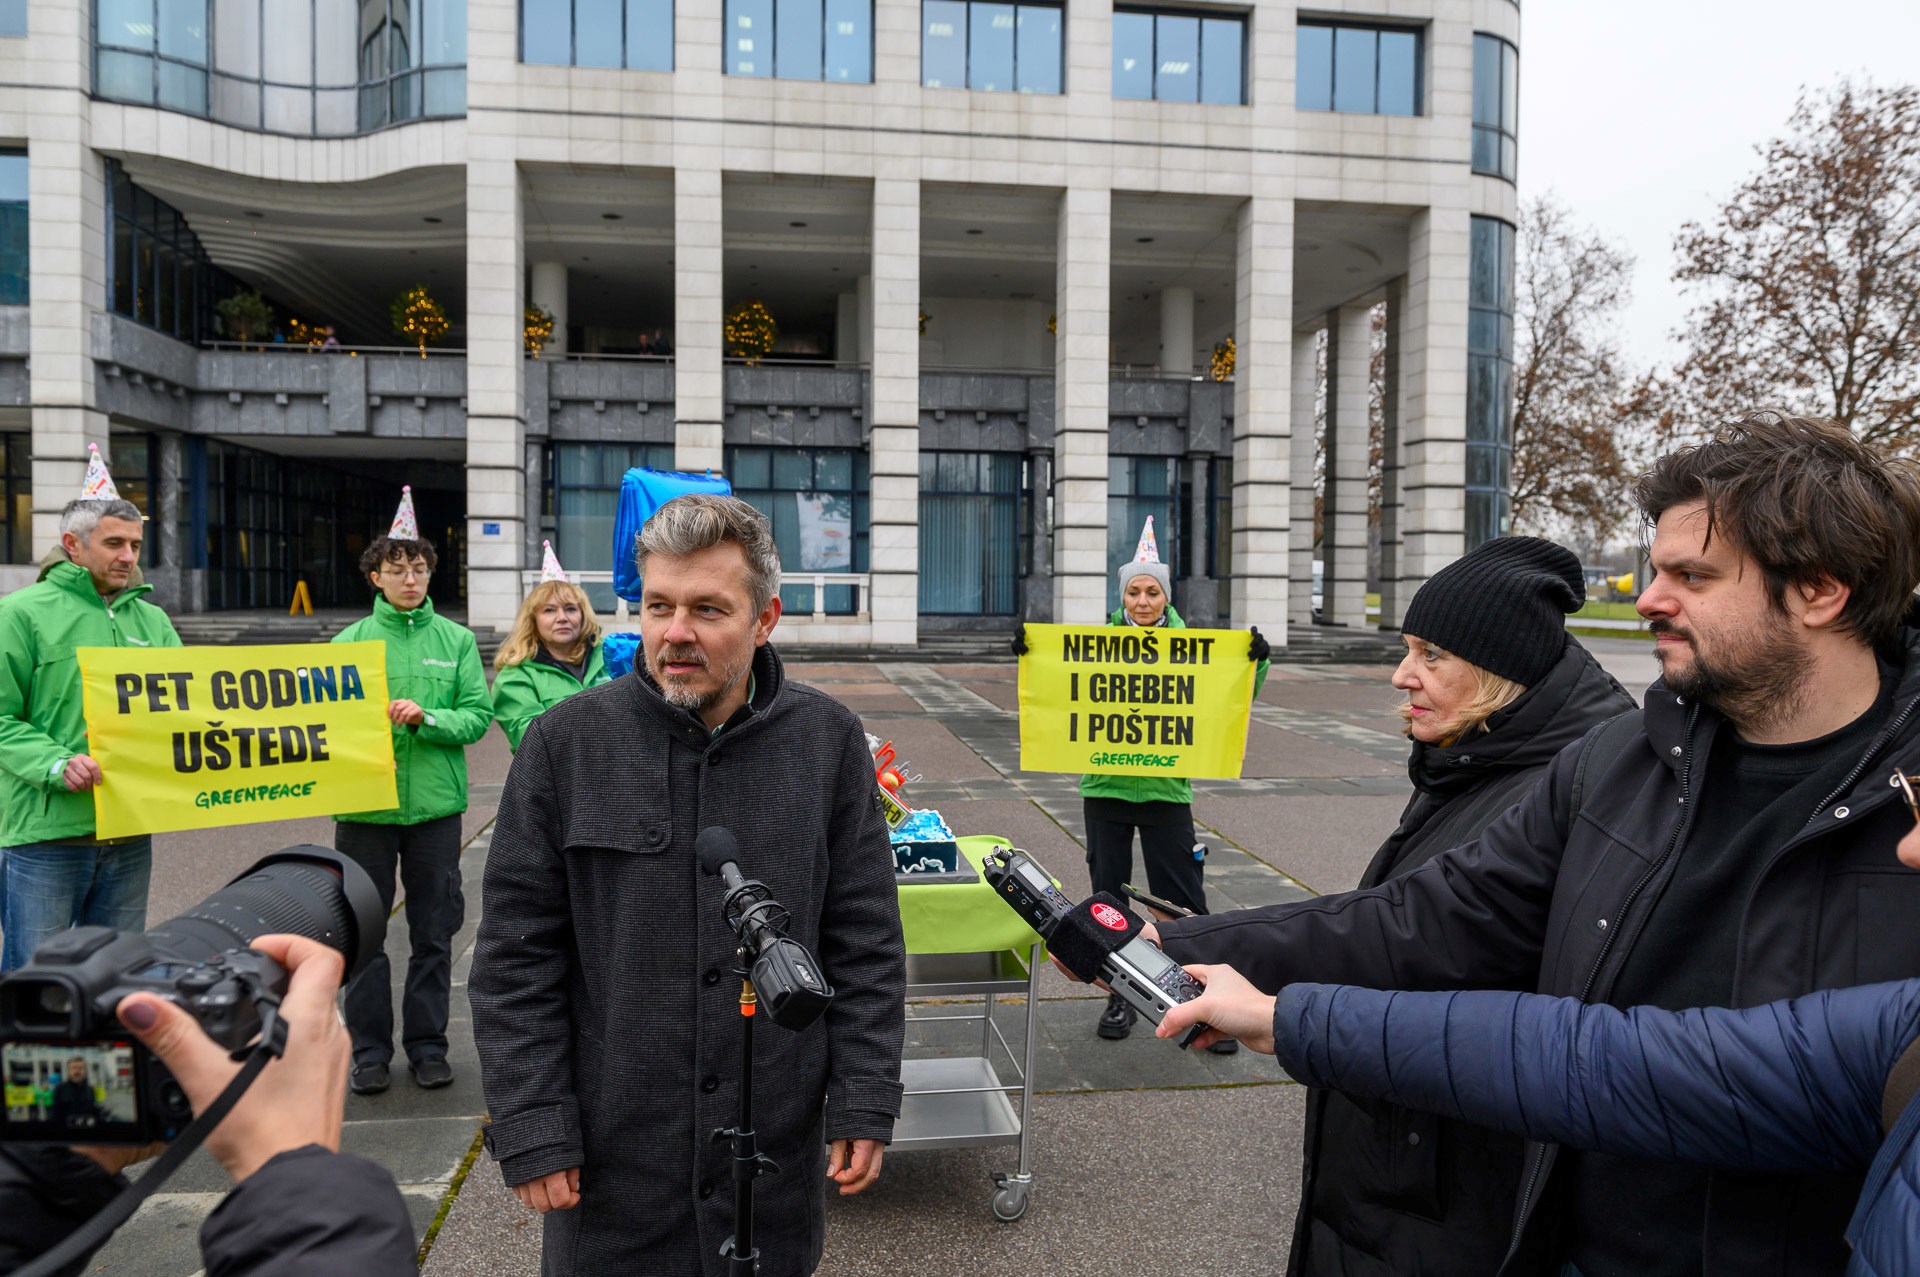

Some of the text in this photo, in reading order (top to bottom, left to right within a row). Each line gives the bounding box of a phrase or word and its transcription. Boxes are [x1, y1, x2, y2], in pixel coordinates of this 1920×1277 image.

[1063, 630, 1215, 665] NEMOŠ BIT
[115, 672, 193, 714] PET
[1070, 672, 1195, 705] I GREBEN
[1069, 708, 1194, 746] I POŠTEN
[172, 720, 330, 774] UŠTEDE
[1089, 752, 1179, 767] GREENPEACE
[195, 781, 317, 809] GREENPEACE
